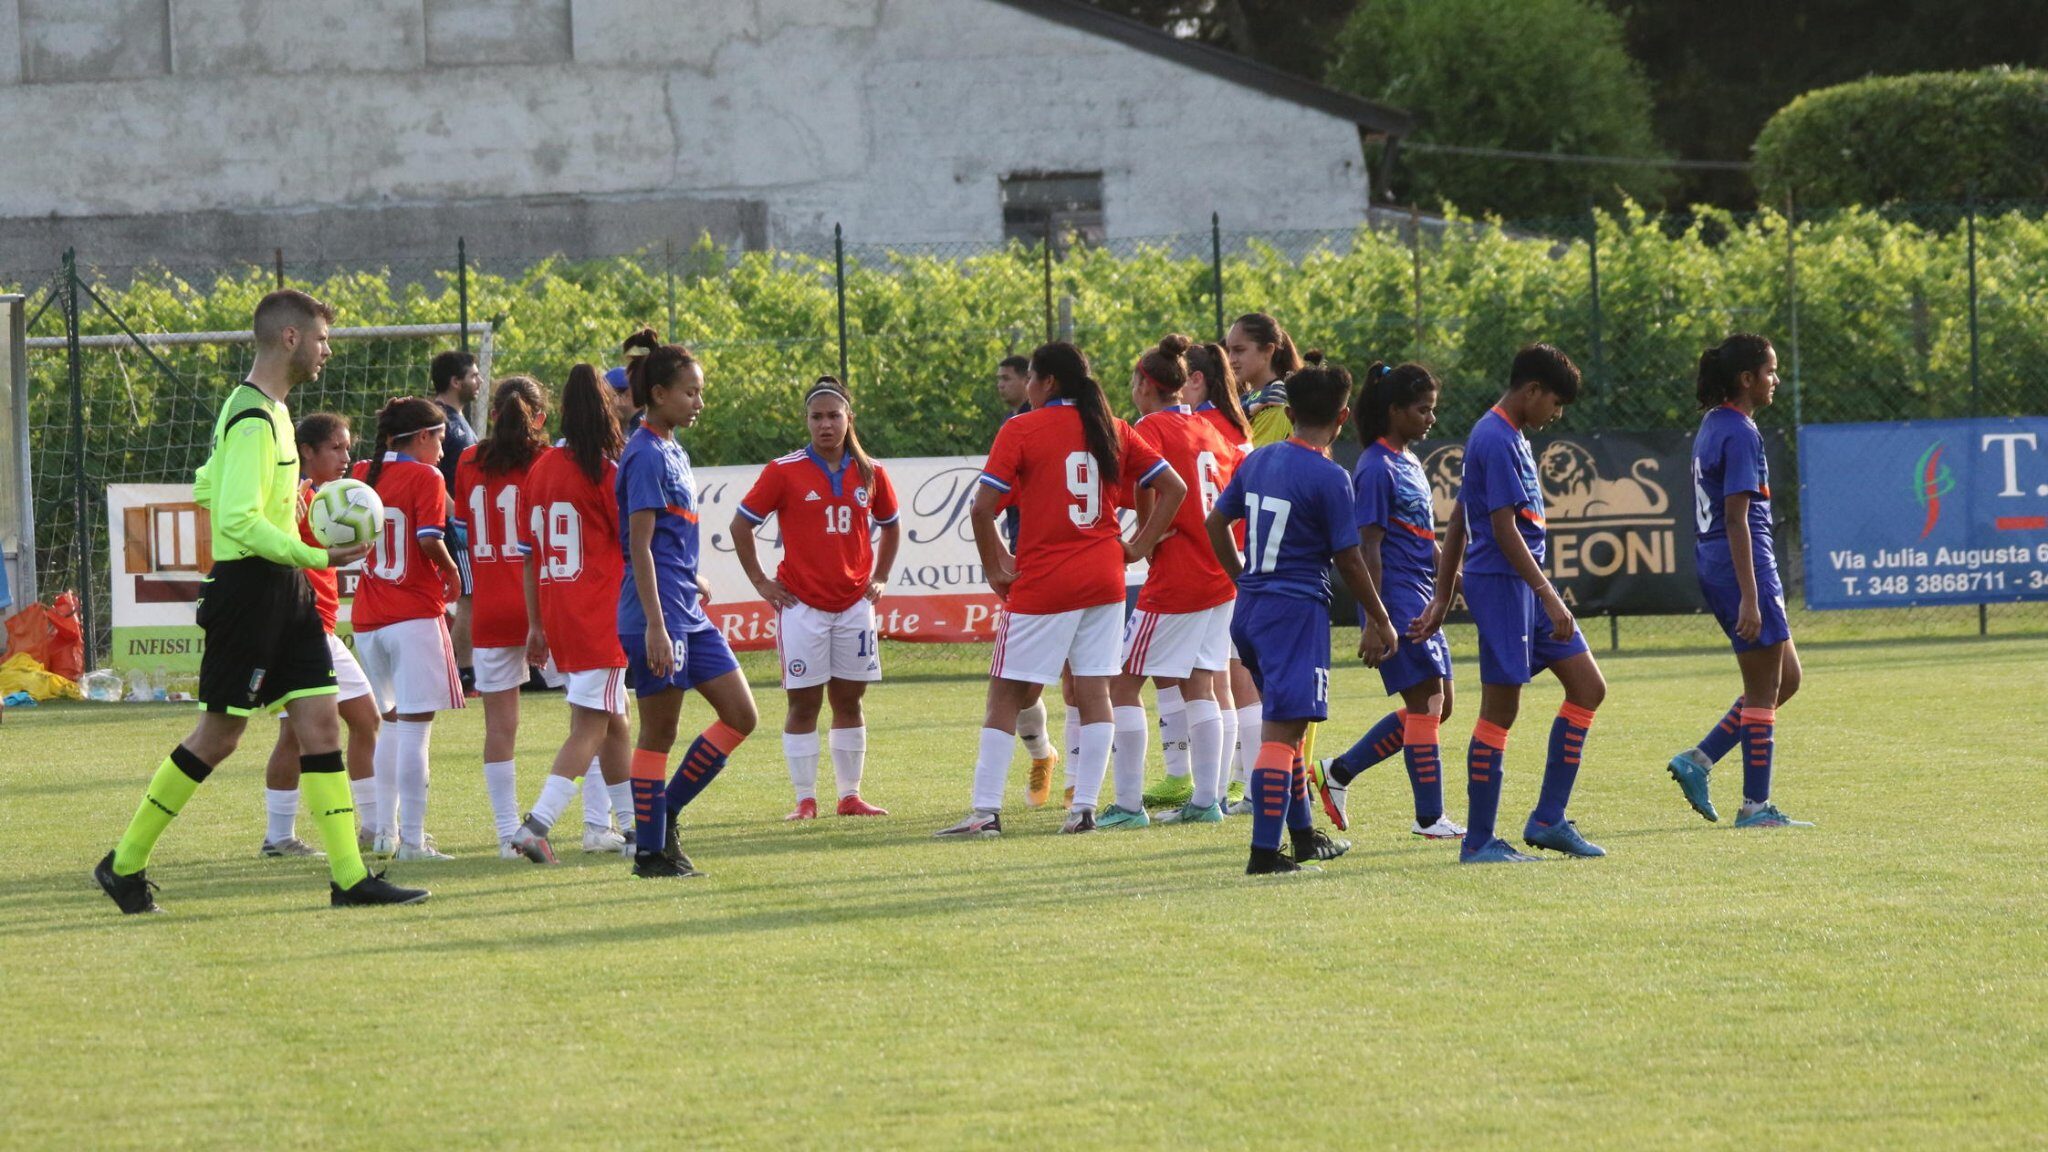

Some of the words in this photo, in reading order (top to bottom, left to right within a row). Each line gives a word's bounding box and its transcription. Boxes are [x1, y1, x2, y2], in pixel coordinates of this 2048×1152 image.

[825, 505, 852, 535] 18
[1065, 451, 1102, 529] 9
[360, 506, 409, 585] 0
[469, 484, 525, 562] 11
[530, 501, 584, 585] 19
[1245, 491, 1291, 574] 17
[1542, 530, 1675, 579] EONI
[1829, 550, 1866, 570] Via
[1872, 548, 1928, 569] Julia
[1934, 543, 2031, 570] Augusta
[1842, 576, 1861, 596] T.
[1868, 575, 1909, 595] 348
[1915, 571, 2004, 593] 3868711
[128, 638, 192, 655] INFISSI
